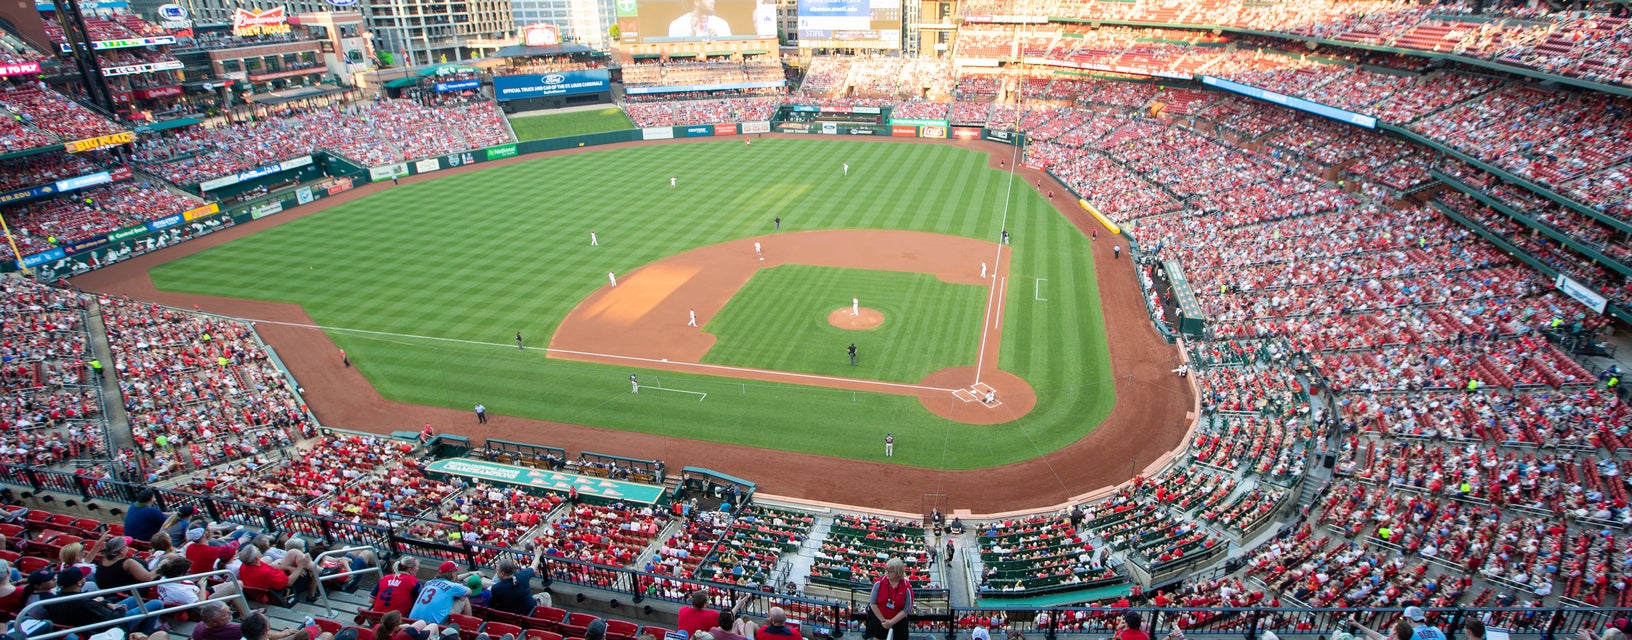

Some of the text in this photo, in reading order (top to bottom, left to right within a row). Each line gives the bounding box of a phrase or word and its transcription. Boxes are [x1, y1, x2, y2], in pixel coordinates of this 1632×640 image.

[239, 14, 287, 27] Budweiser
[236, 24, 292, 36] BREW HOUSE
[7, 66, 21, 74] TO
[21, 65, 36, 73] FLY
[582, 80, 603, 88] CARDINALS
[75, 133, 131, 152] BIG MAC
[379, 587, 395, 607] 4
[417, 587, 437, 605] 13
